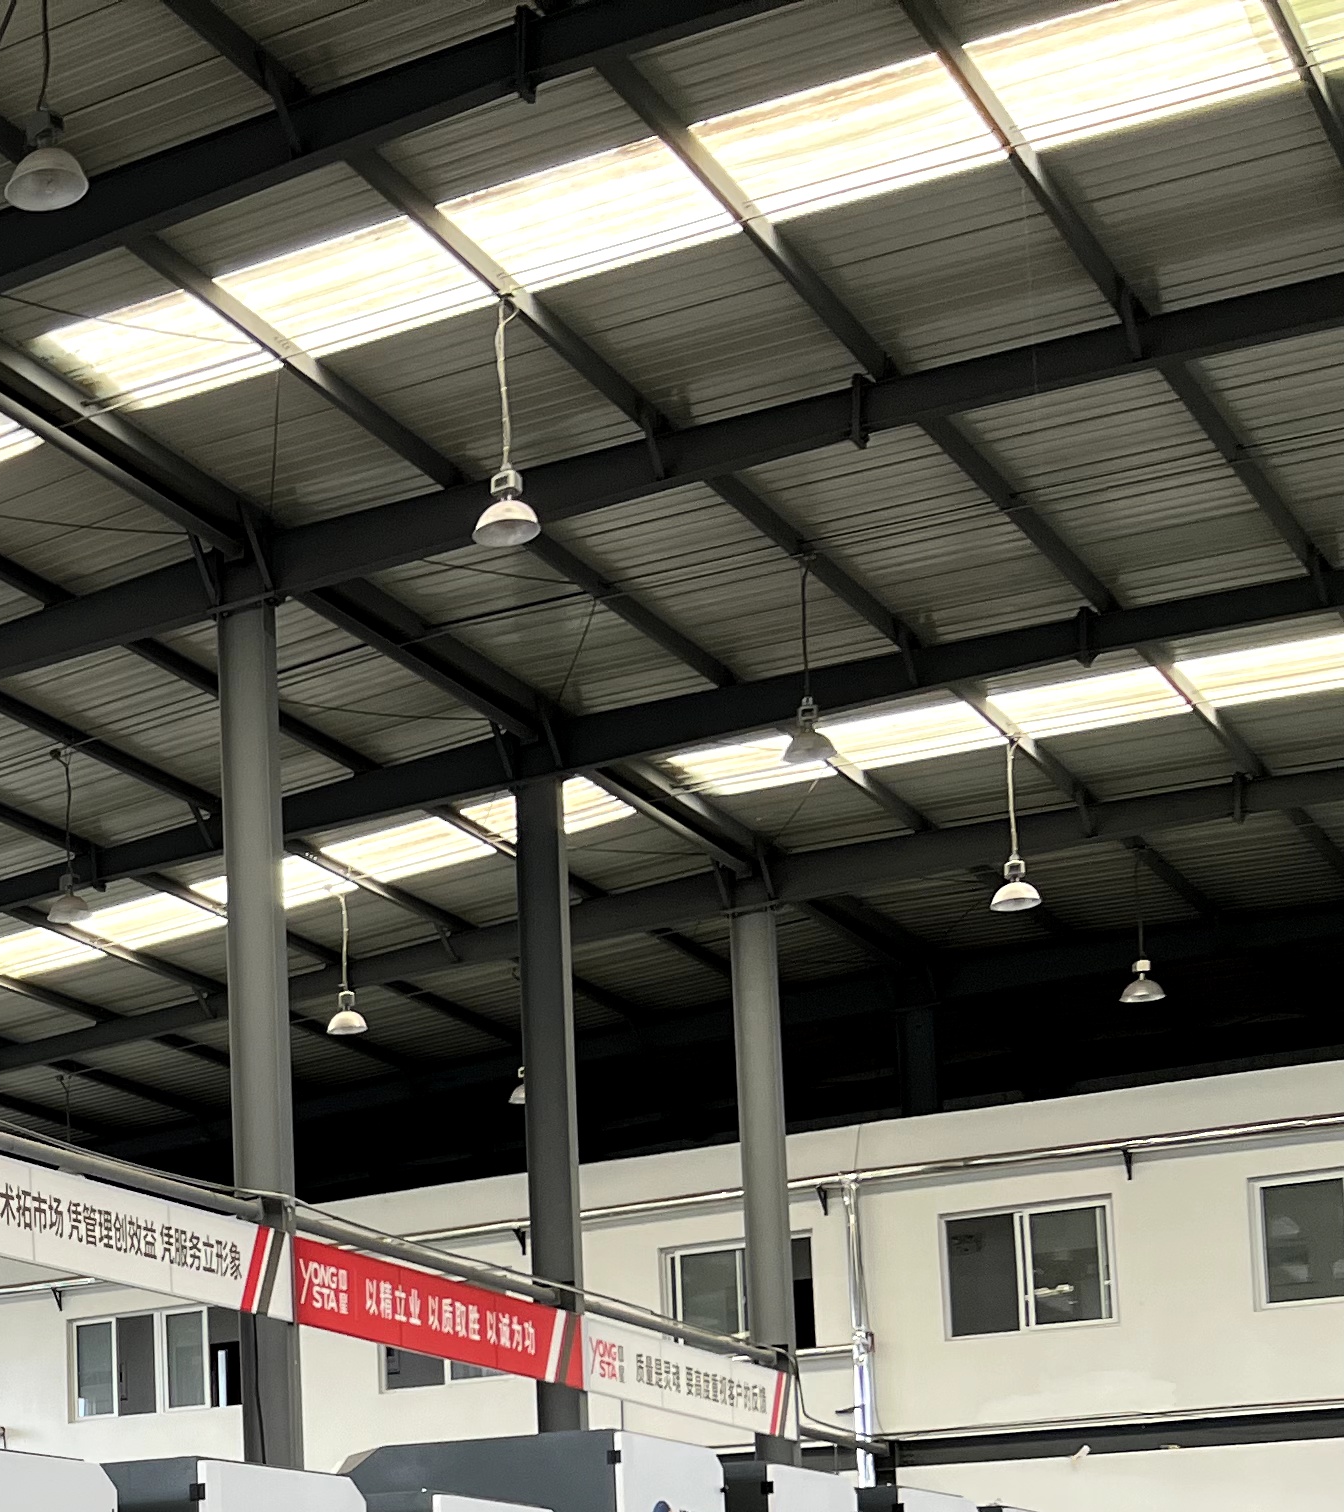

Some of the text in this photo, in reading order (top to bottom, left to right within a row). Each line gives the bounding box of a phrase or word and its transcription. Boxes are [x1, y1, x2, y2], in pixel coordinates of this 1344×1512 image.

[67, 1200, 157, 1260] 凭管理创效益
[160, 1225, 243, 1280] 凭服务立形象
[299, 1258, 338, 1304] YONG
[312, 1286, 338, 1312] STA
[365, 1278, 421, 1326] 以精立业
[428, 1295, 481, 1341] 以质取胜
[589, 1336, 617, 1374] YONG
[599, 1360, 617, 1381] STA
